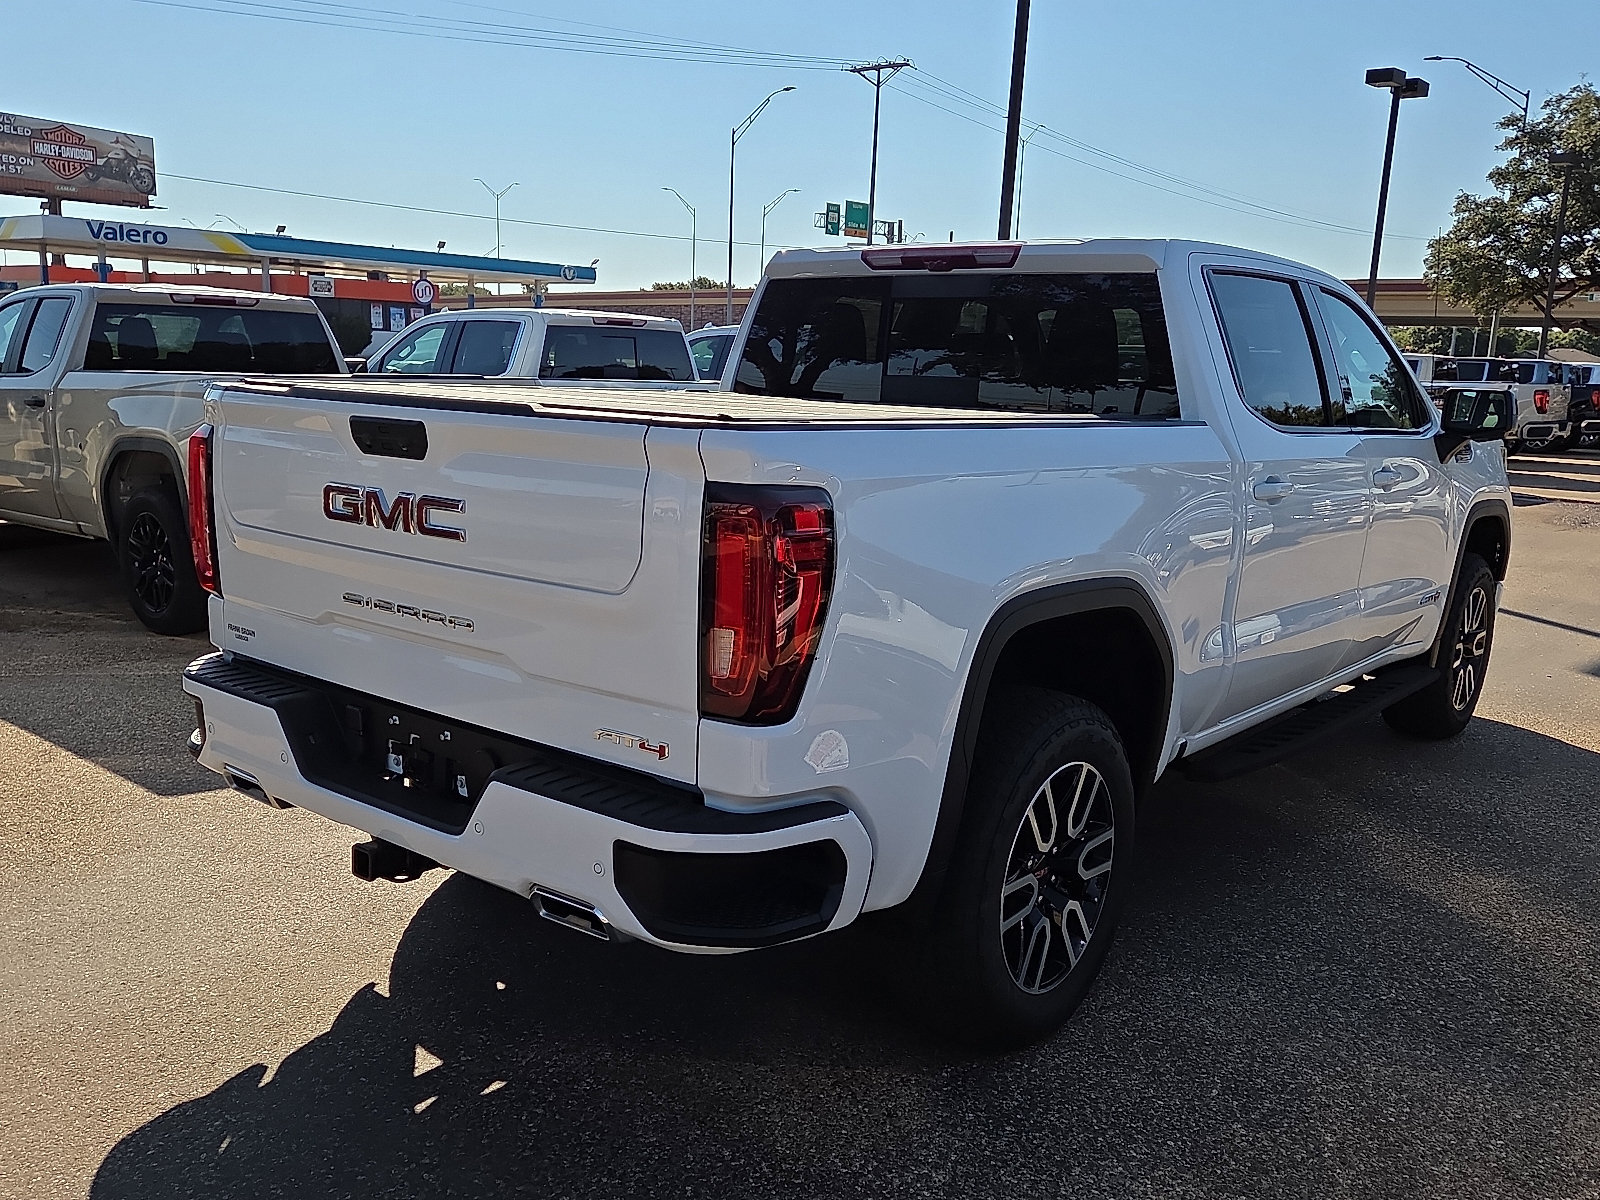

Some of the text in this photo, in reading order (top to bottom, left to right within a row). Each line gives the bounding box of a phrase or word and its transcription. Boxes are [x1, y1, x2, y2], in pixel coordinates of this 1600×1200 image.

[47, 131, 79, 145] MOTOR
[19, 156, 34, 167] ON
[34, 141, 93, 161] HARLEY-DAVIDSON
[48, 159, 81, 175] CYCLES
[86, 220, 168, 245] Valero
[322, 481, 467, 543] GMC
[342, 591, 475, 633] SIERRA
[593, 727, 670, 761] AT4
